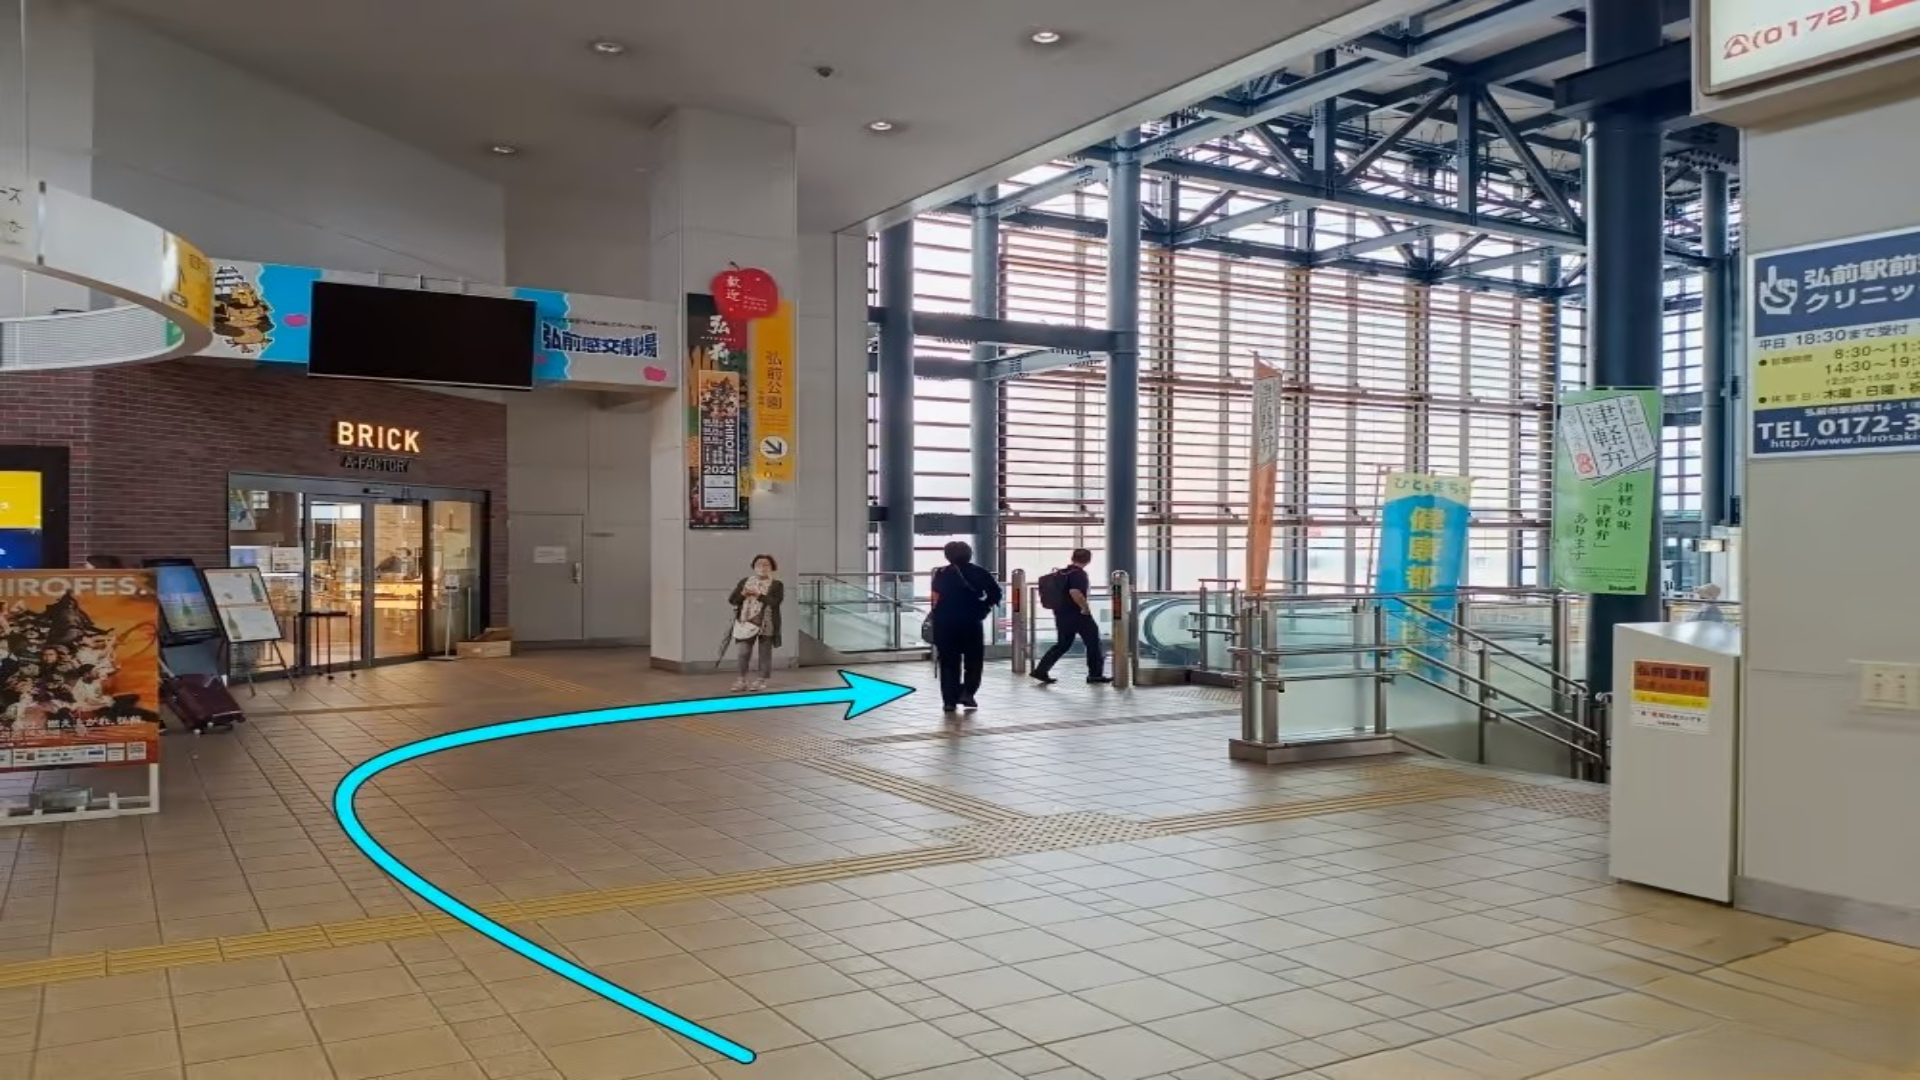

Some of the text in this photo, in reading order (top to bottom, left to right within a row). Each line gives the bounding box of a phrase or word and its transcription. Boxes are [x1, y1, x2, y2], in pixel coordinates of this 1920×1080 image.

[1752, 2, 1861, 49] (0172)
[1804, 253, 1920, 290] 弘前駅前
[1805, 283, 1920, 314] クリニッ
[541, 321, 660, 359] 弘前感交劇場
[1759, 323, 1909, 350] 平日 18:30まで受付
[765, 350, 783, 410] 弘前公園
[337, 421, 420, 453] BRICK
[1584, 403, 1629, 471] 津軽弁
[1757, 413, 1920, 440] TEL 0172-3
[703, 465, 736, 475] 2024
[1617, 482, 1634, 530] 津軽の味
[1570, 512, 1588, 561] あります
